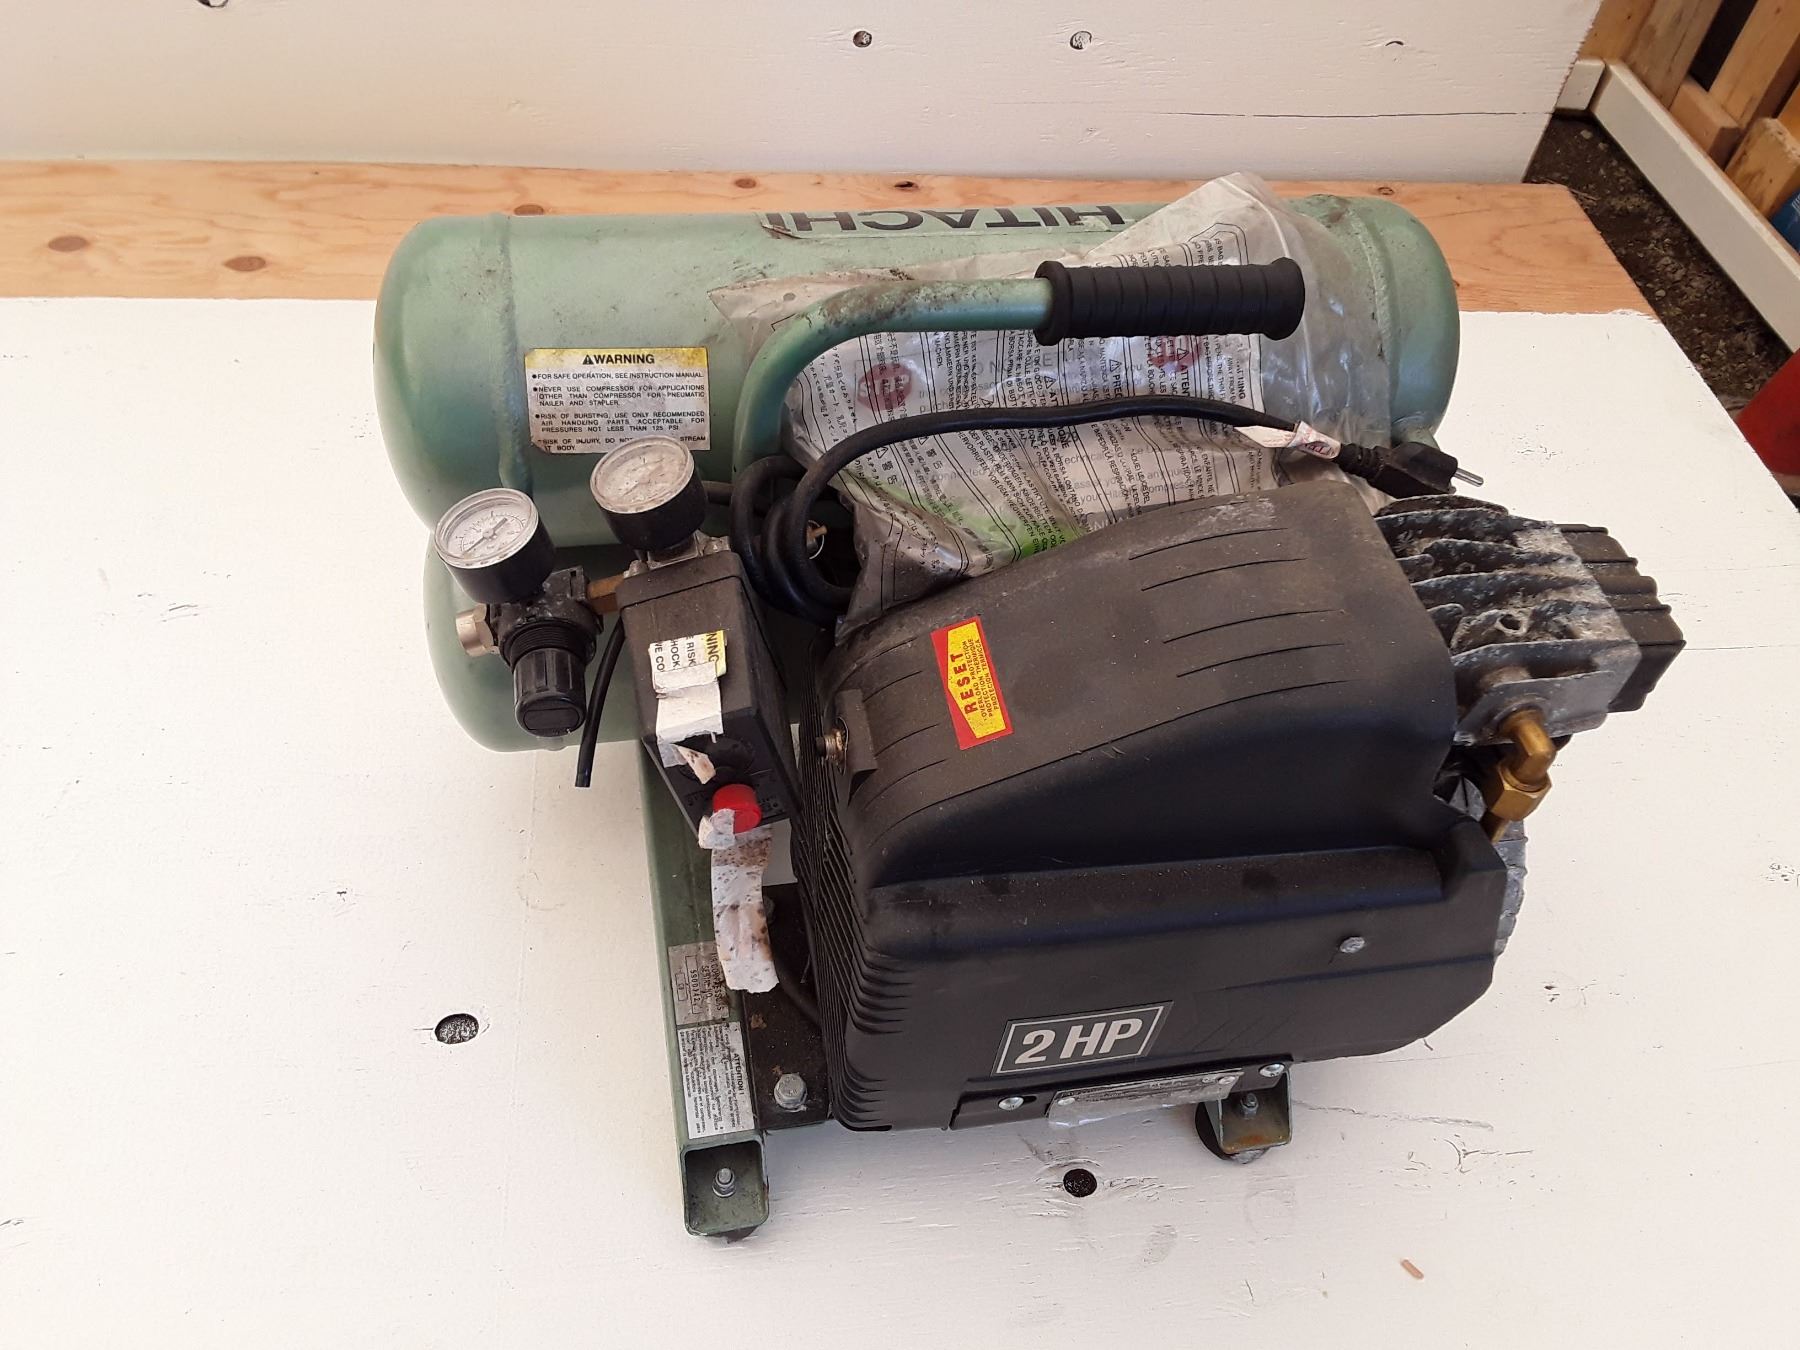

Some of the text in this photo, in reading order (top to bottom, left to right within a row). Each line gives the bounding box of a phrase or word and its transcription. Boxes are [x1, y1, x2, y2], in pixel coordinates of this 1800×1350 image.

[766, 206, 1126, 232] HITACHI
[594, 354, 655, 364] WARNING
[655, 655, 666, 673] CO
[686, 642, 697, 665] RISK
[950, 653, 978, 715] RESET
[962, 640, 986, 717] OVERLOAD PROTECTION
[979, 676, 993, 717] PROTECTION
[1014, 1018, 1143, 1065] 2 HP
[734, 1053, 744, 1091] ATTENTION
